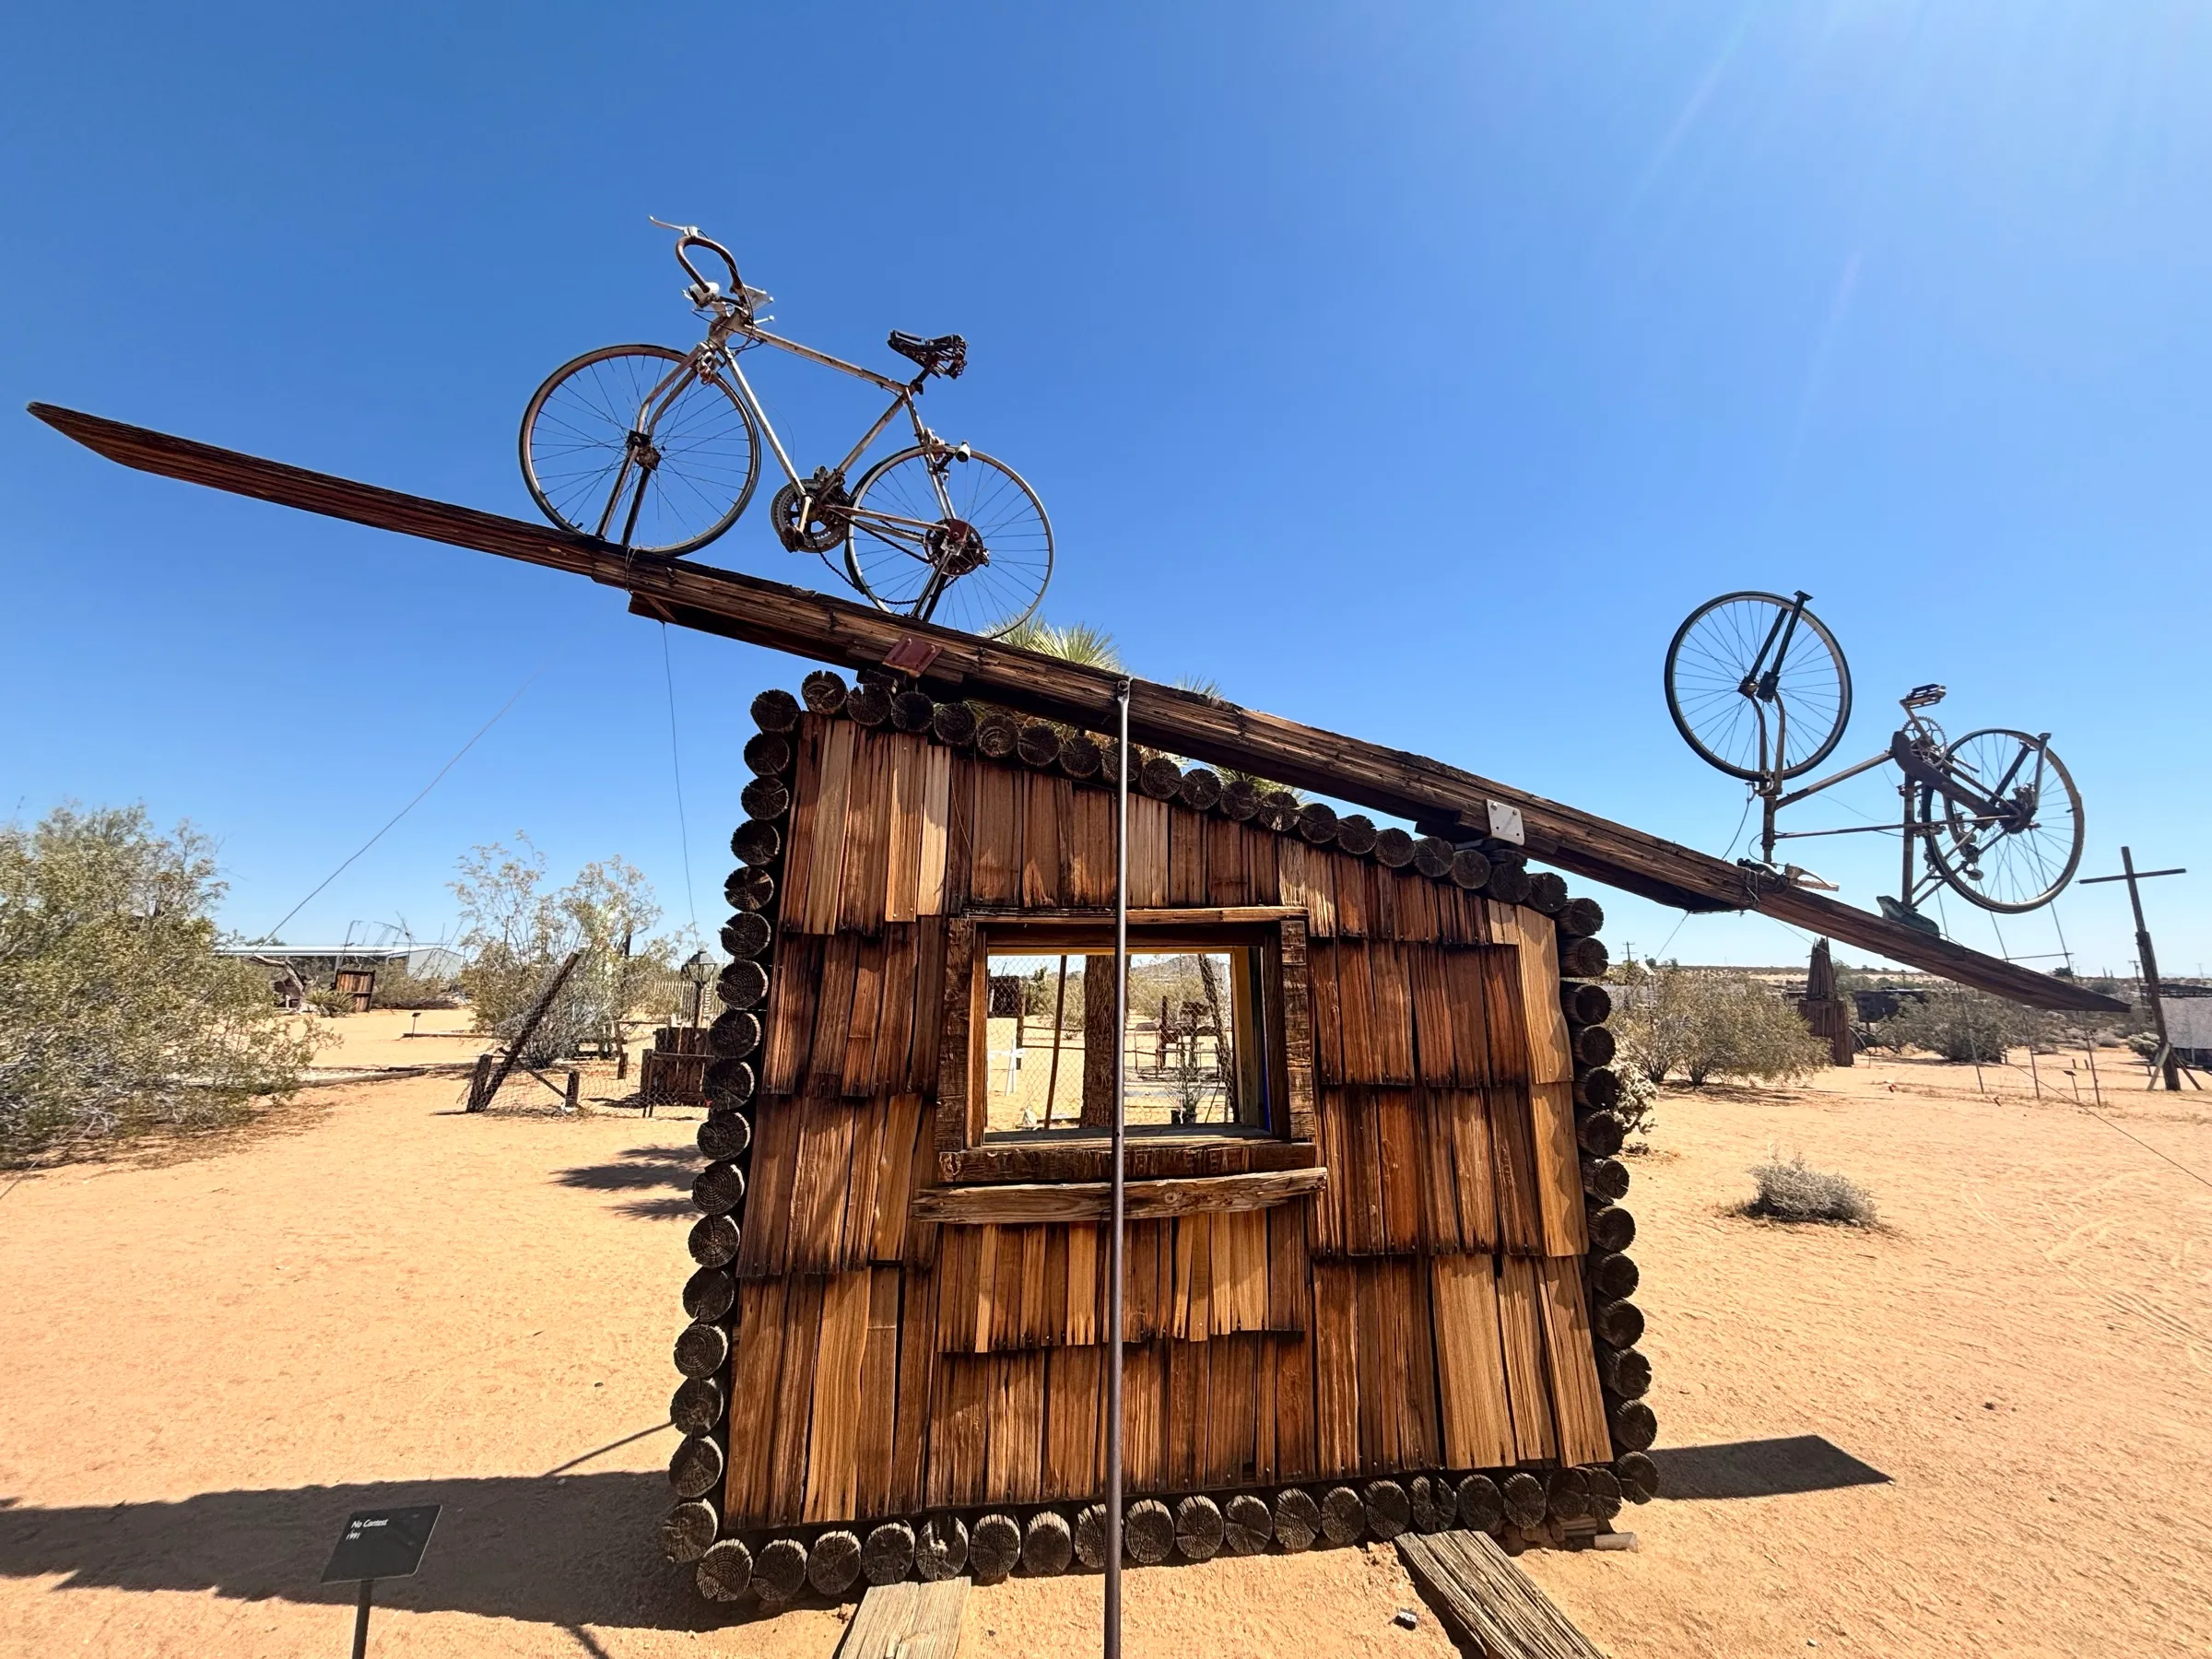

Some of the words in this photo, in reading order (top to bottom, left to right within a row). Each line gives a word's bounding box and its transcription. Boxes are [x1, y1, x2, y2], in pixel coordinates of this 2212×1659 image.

[351, 1520, 362, 1528] No
[363, 1519, 389, 1527] Contest
[346, 1532, 360, 1540] 1991
